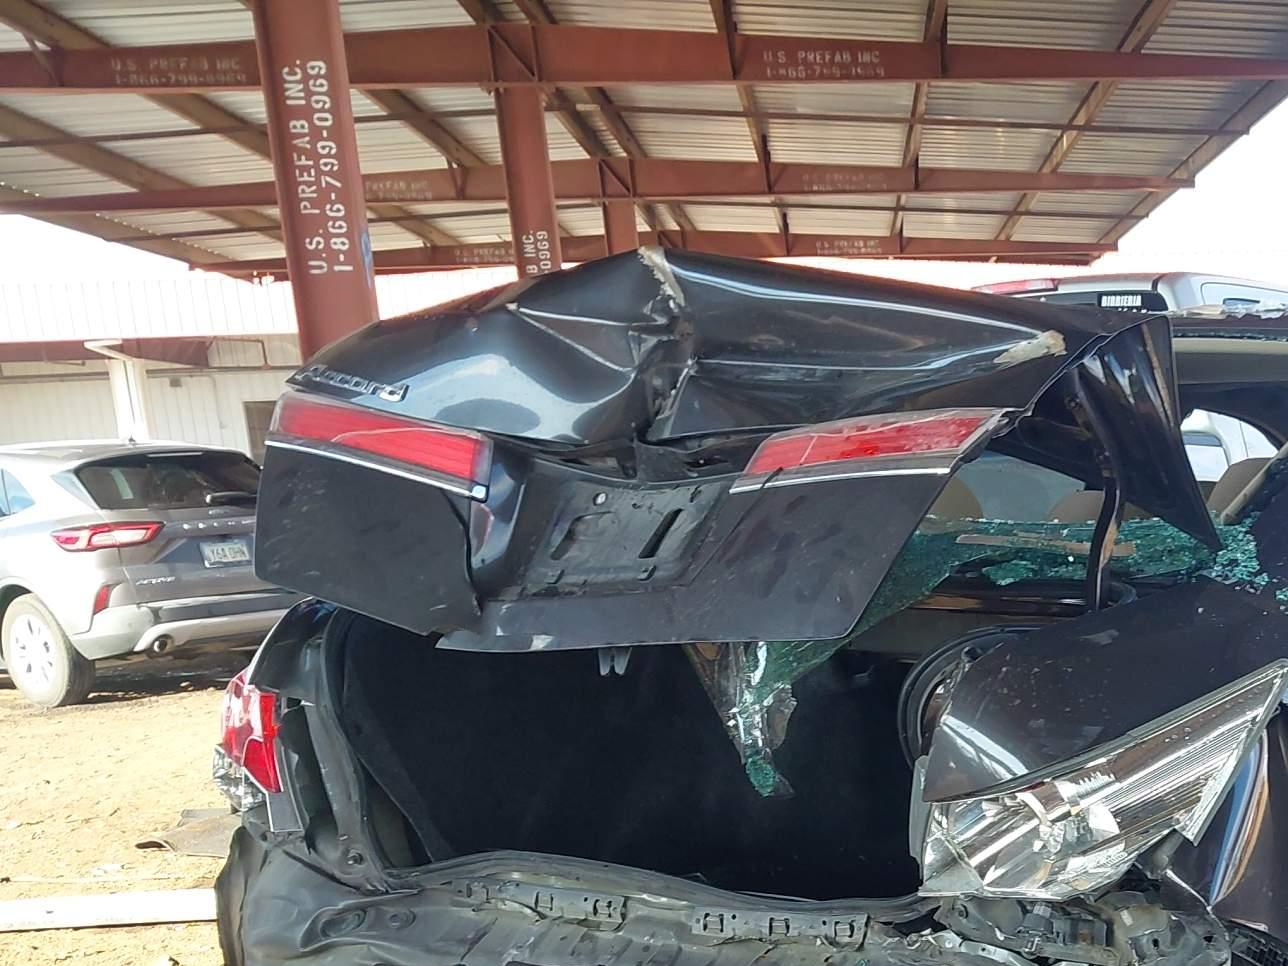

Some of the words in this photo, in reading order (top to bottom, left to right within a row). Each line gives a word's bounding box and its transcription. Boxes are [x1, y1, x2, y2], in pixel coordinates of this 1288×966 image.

[798, 50, 852, 64] PREFAB
[282, 59, 306, 105] INC.
[289, 119, 320, 214] PREFAB
[306, 60, 353, 272] 1-866-799-0969
[305, 229, 327, 274] U.S.
[522, 230, 537, 257] INC.
[297, 366, 409, 403] Accord
